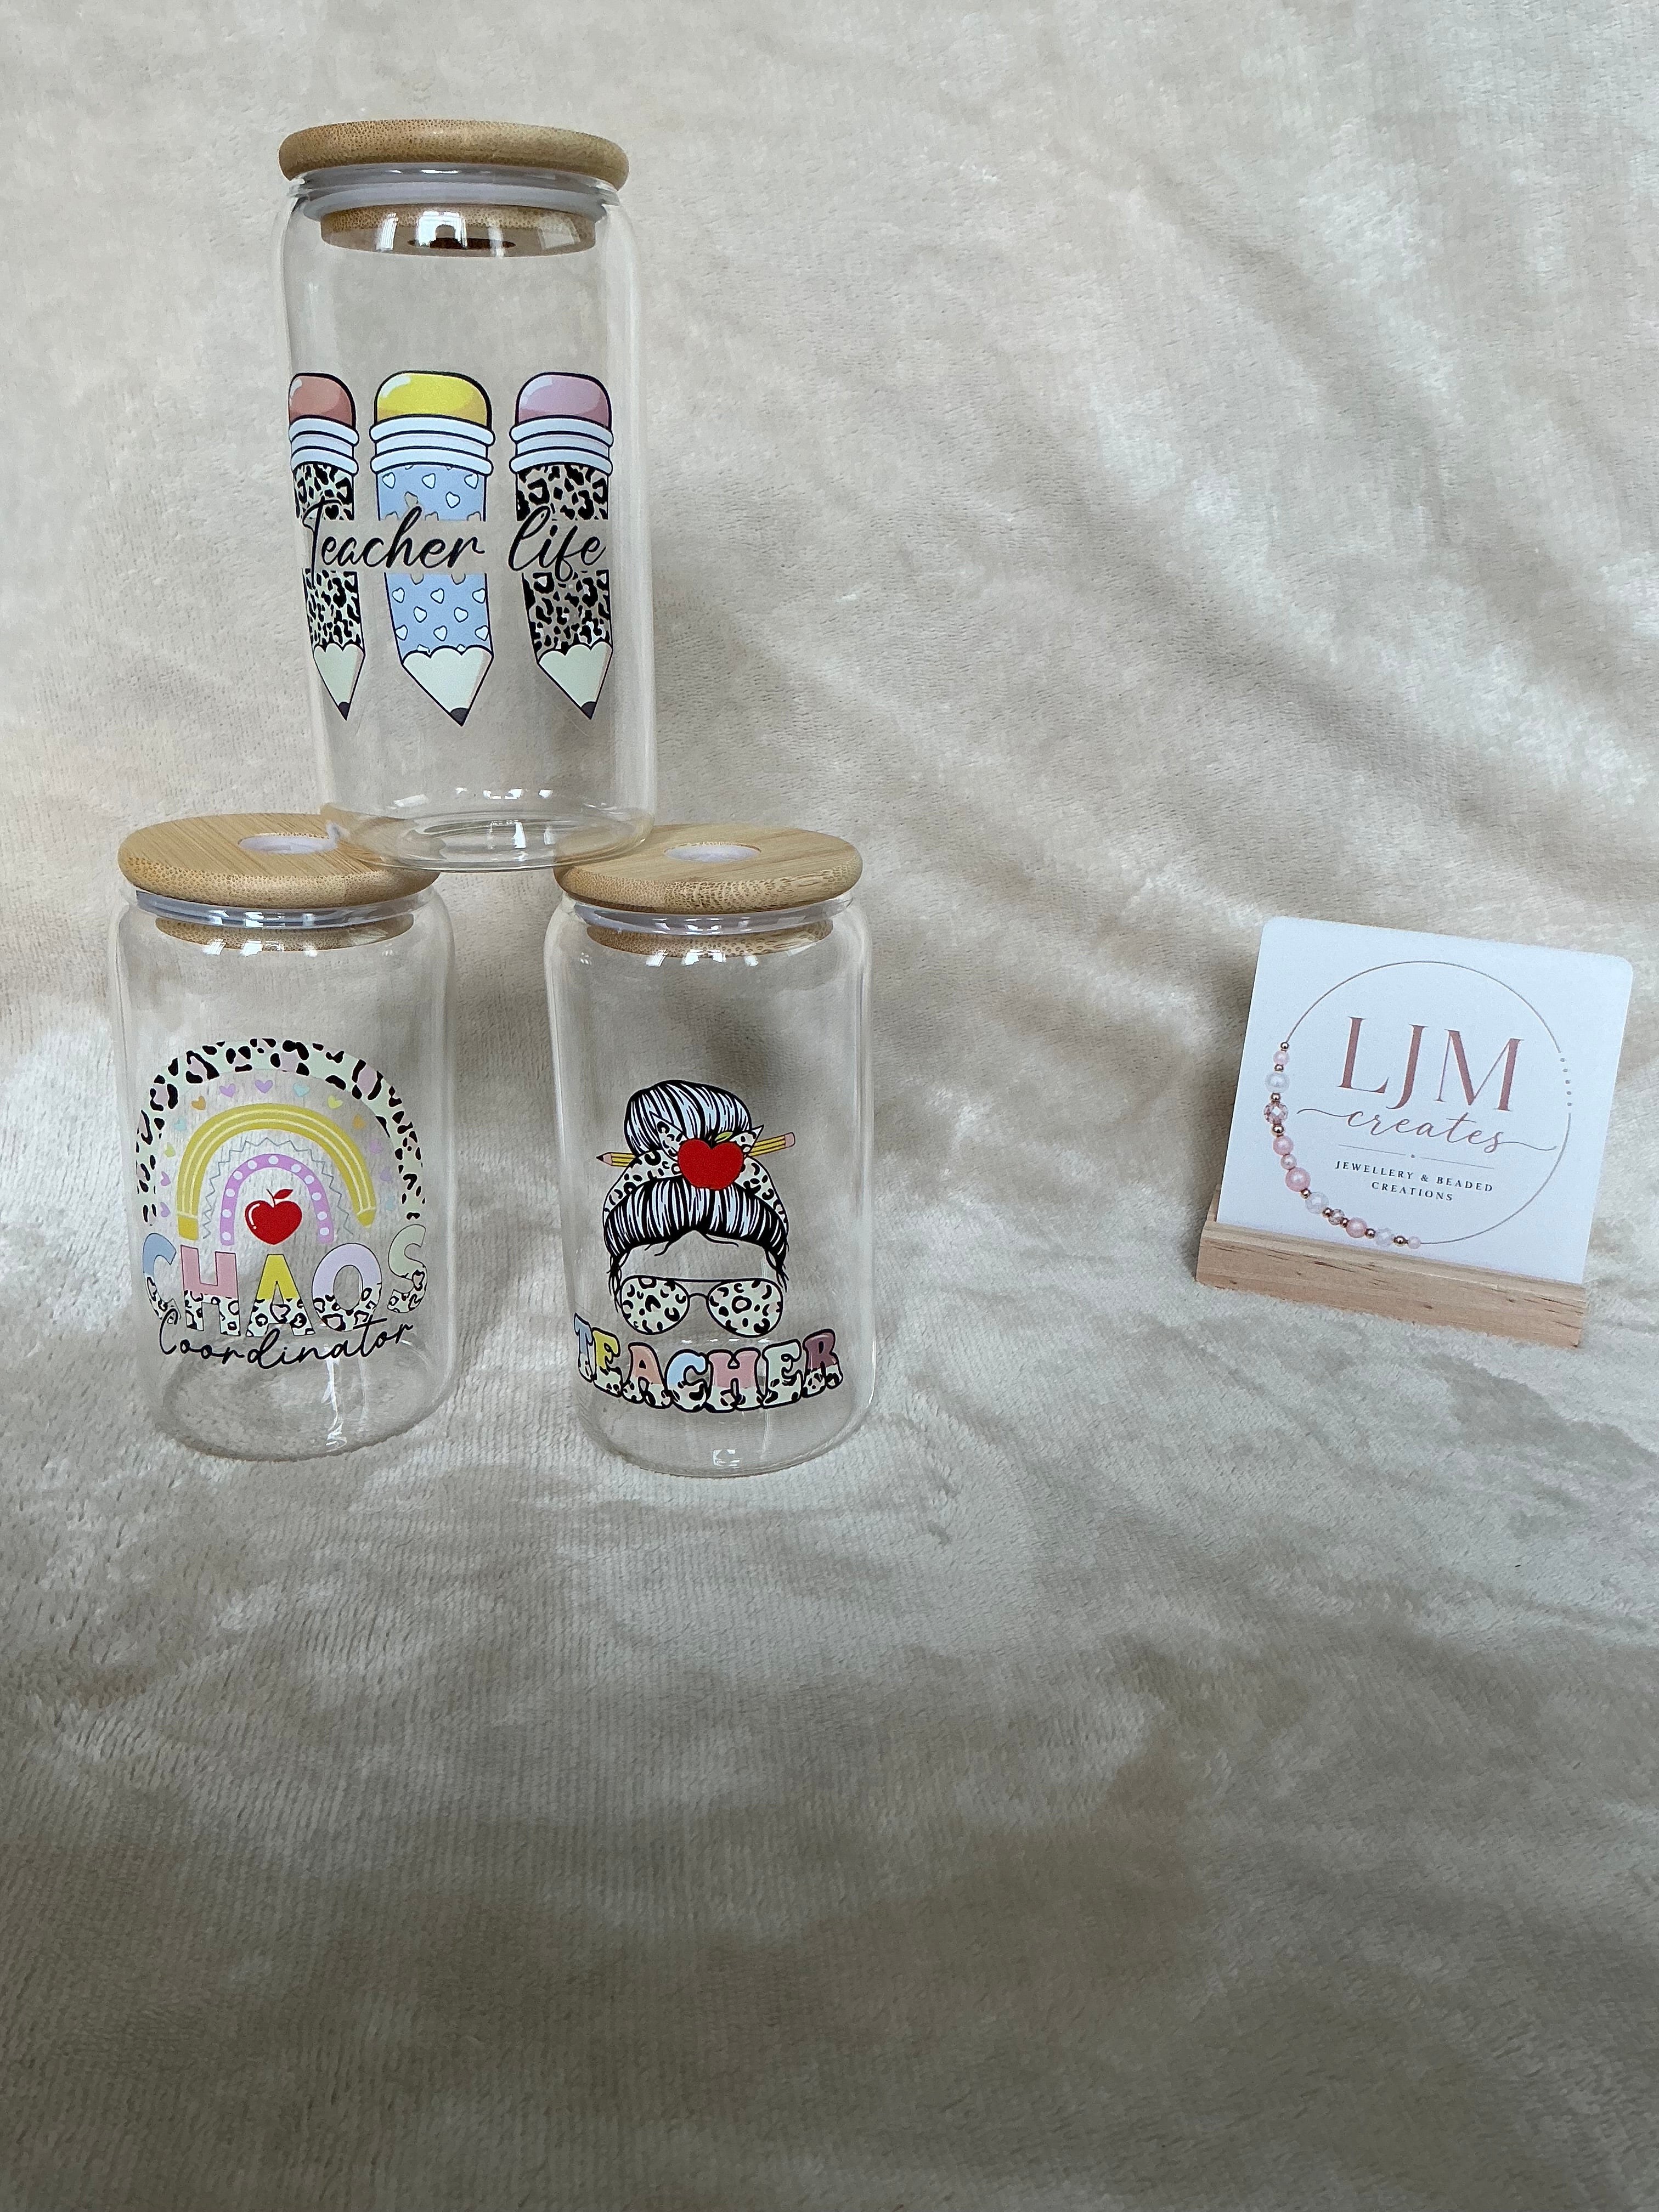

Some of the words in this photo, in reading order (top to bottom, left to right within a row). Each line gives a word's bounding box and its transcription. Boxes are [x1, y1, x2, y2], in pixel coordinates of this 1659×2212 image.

[302, 499, 485, 589] Teacher
[508, 505, 607, 582] life
[1338, 1015, 1525, 1112] LJM
[1296, 1108, 1558, 1153] creates
[1334, 1160, 1414, 1181] JEWELLERY
[1420, 1173, 1429, 1182] &
[1436, 1175, 1494, 1193] BEADED
[1371, 1181, 1454, 1201] CREATIONS
[142, 1223, 428, 1337] CHAOS
[159, 1308, 414, 1370] Coordinator
[573, 1312, 844, 1414] TEACHER
